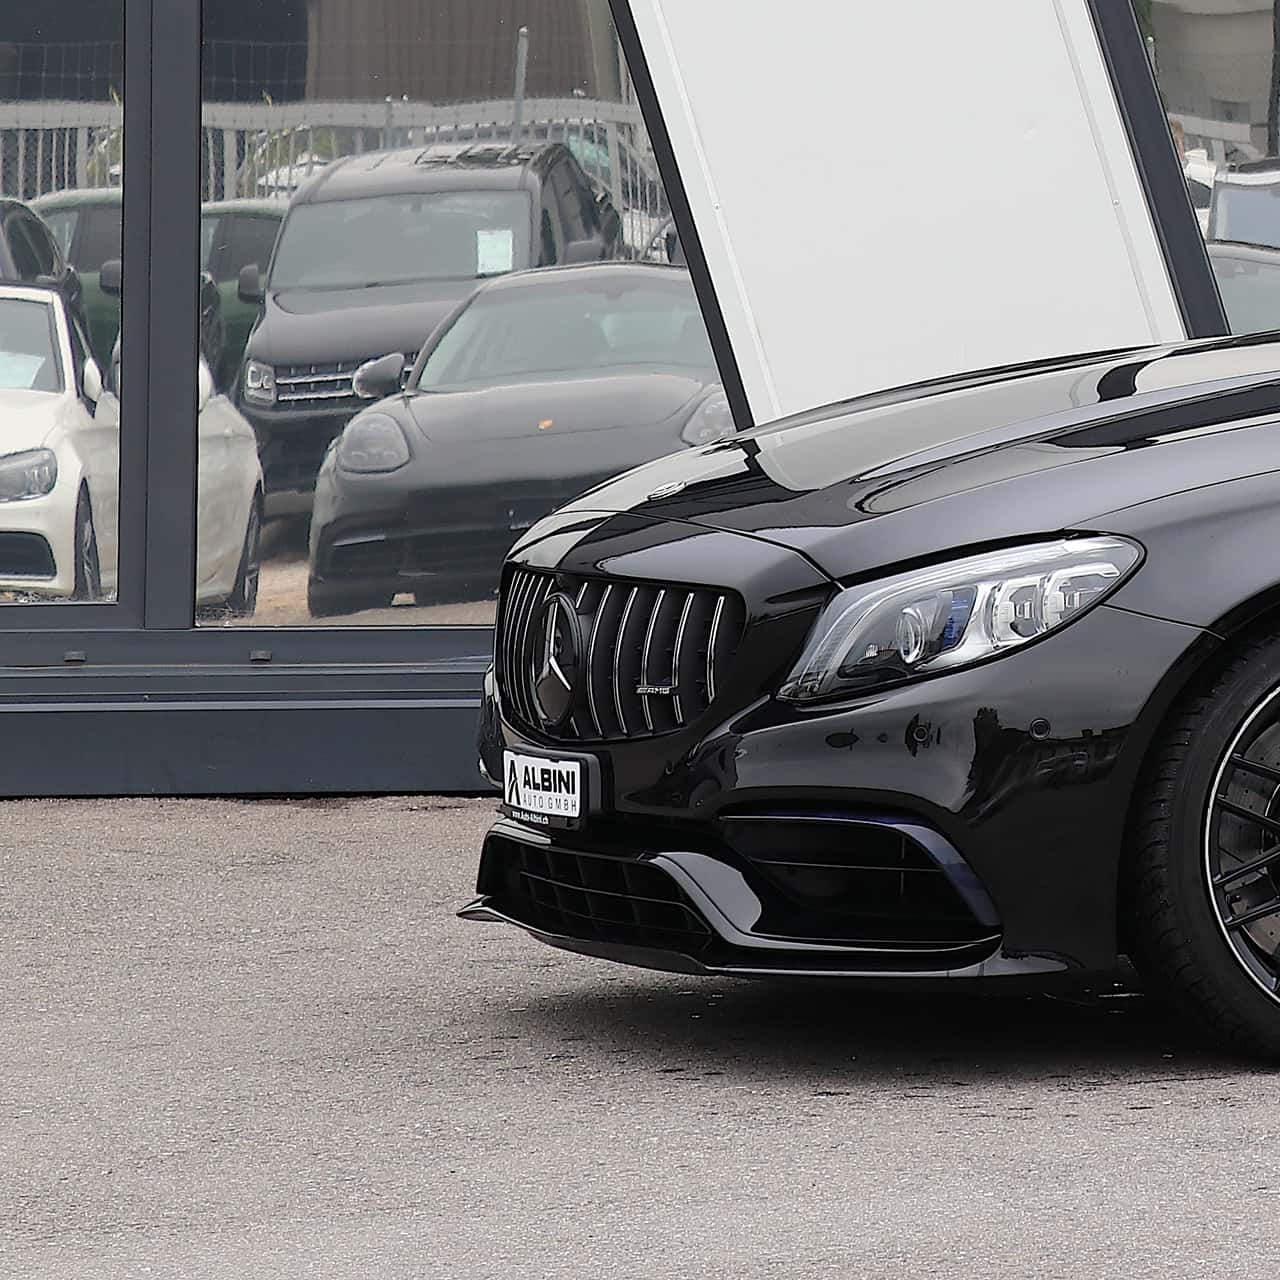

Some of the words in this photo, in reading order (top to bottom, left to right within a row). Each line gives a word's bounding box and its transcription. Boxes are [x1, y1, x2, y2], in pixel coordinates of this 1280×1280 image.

[523, 765, 576, 795] ALBINI
[523, 793, 544, 809] AUTO
[547, 797, 577, 812] GMBH
